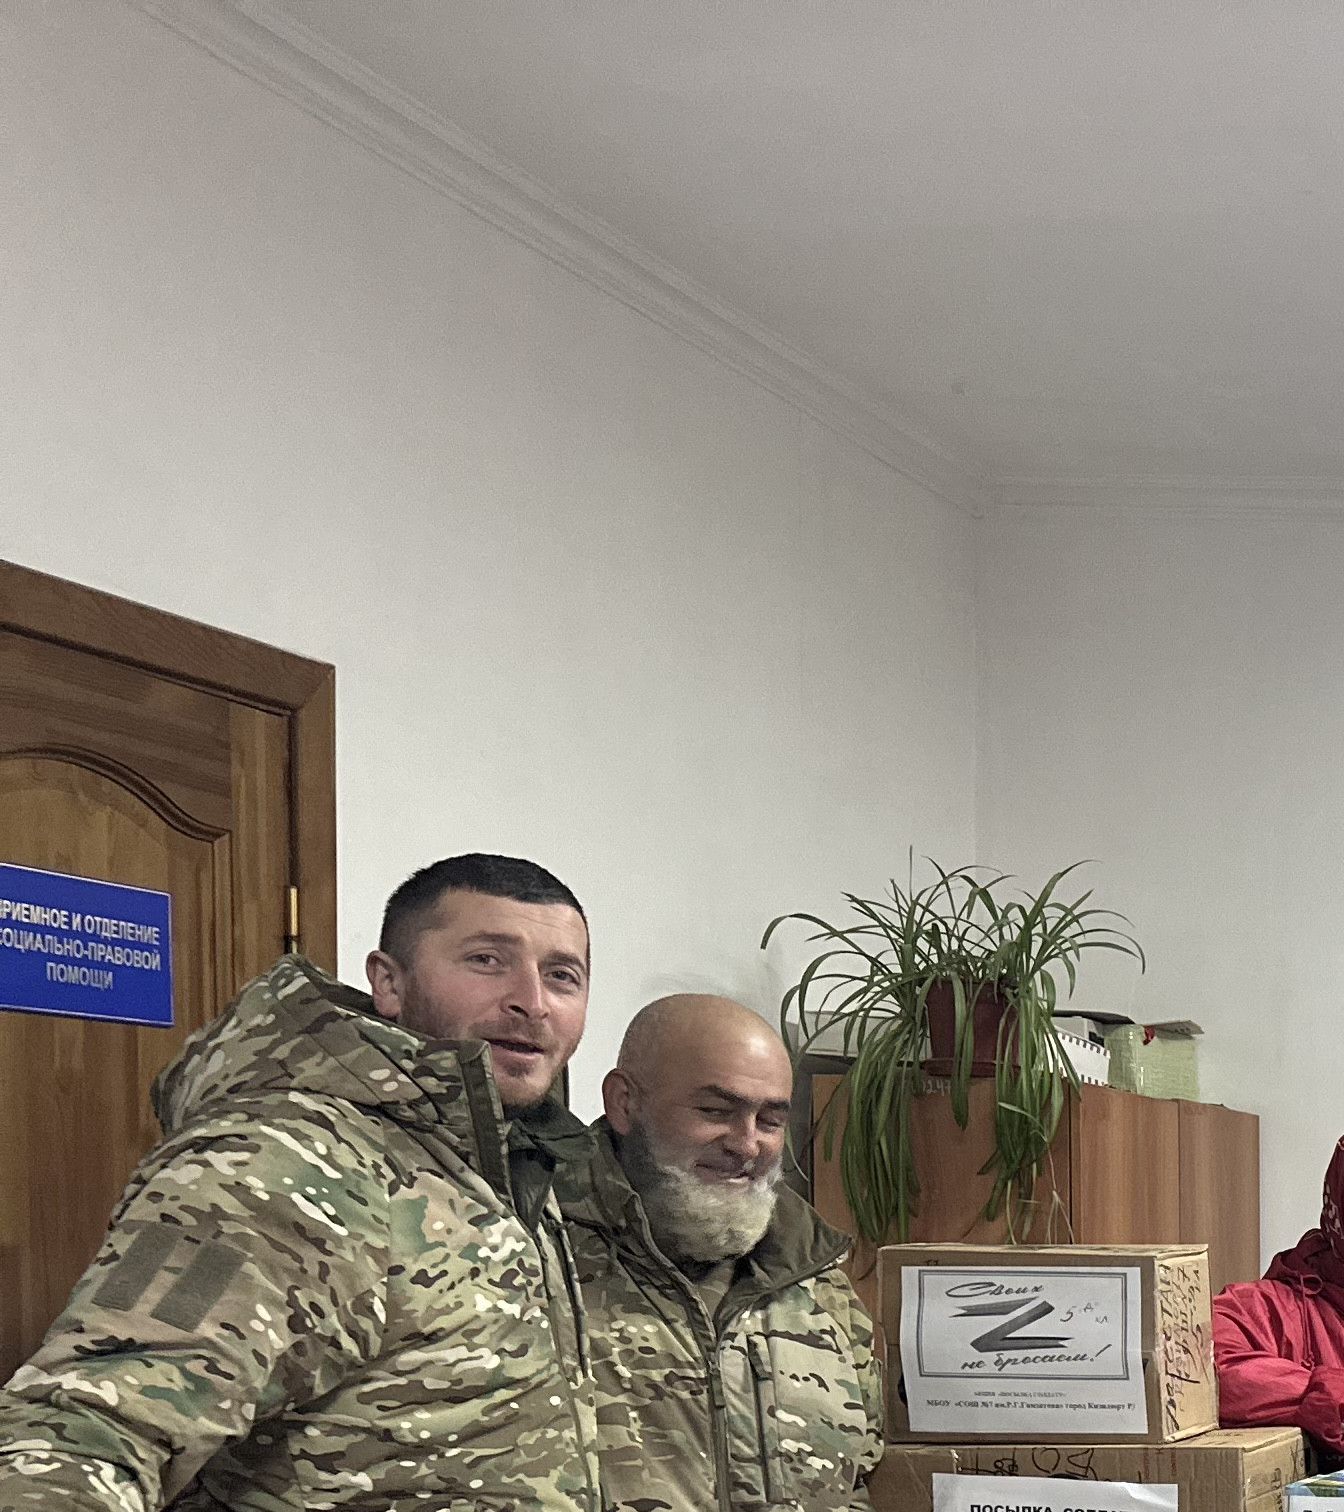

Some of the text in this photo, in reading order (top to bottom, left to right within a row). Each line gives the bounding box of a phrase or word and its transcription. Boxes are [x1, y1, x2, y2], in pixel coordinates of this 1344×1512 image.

[72, 913, 81, 931] И
[84, 915, 160, 945] ОТДЕЛЕНИЕ
[46, 962, 113, 990] ПОМОЩИ
